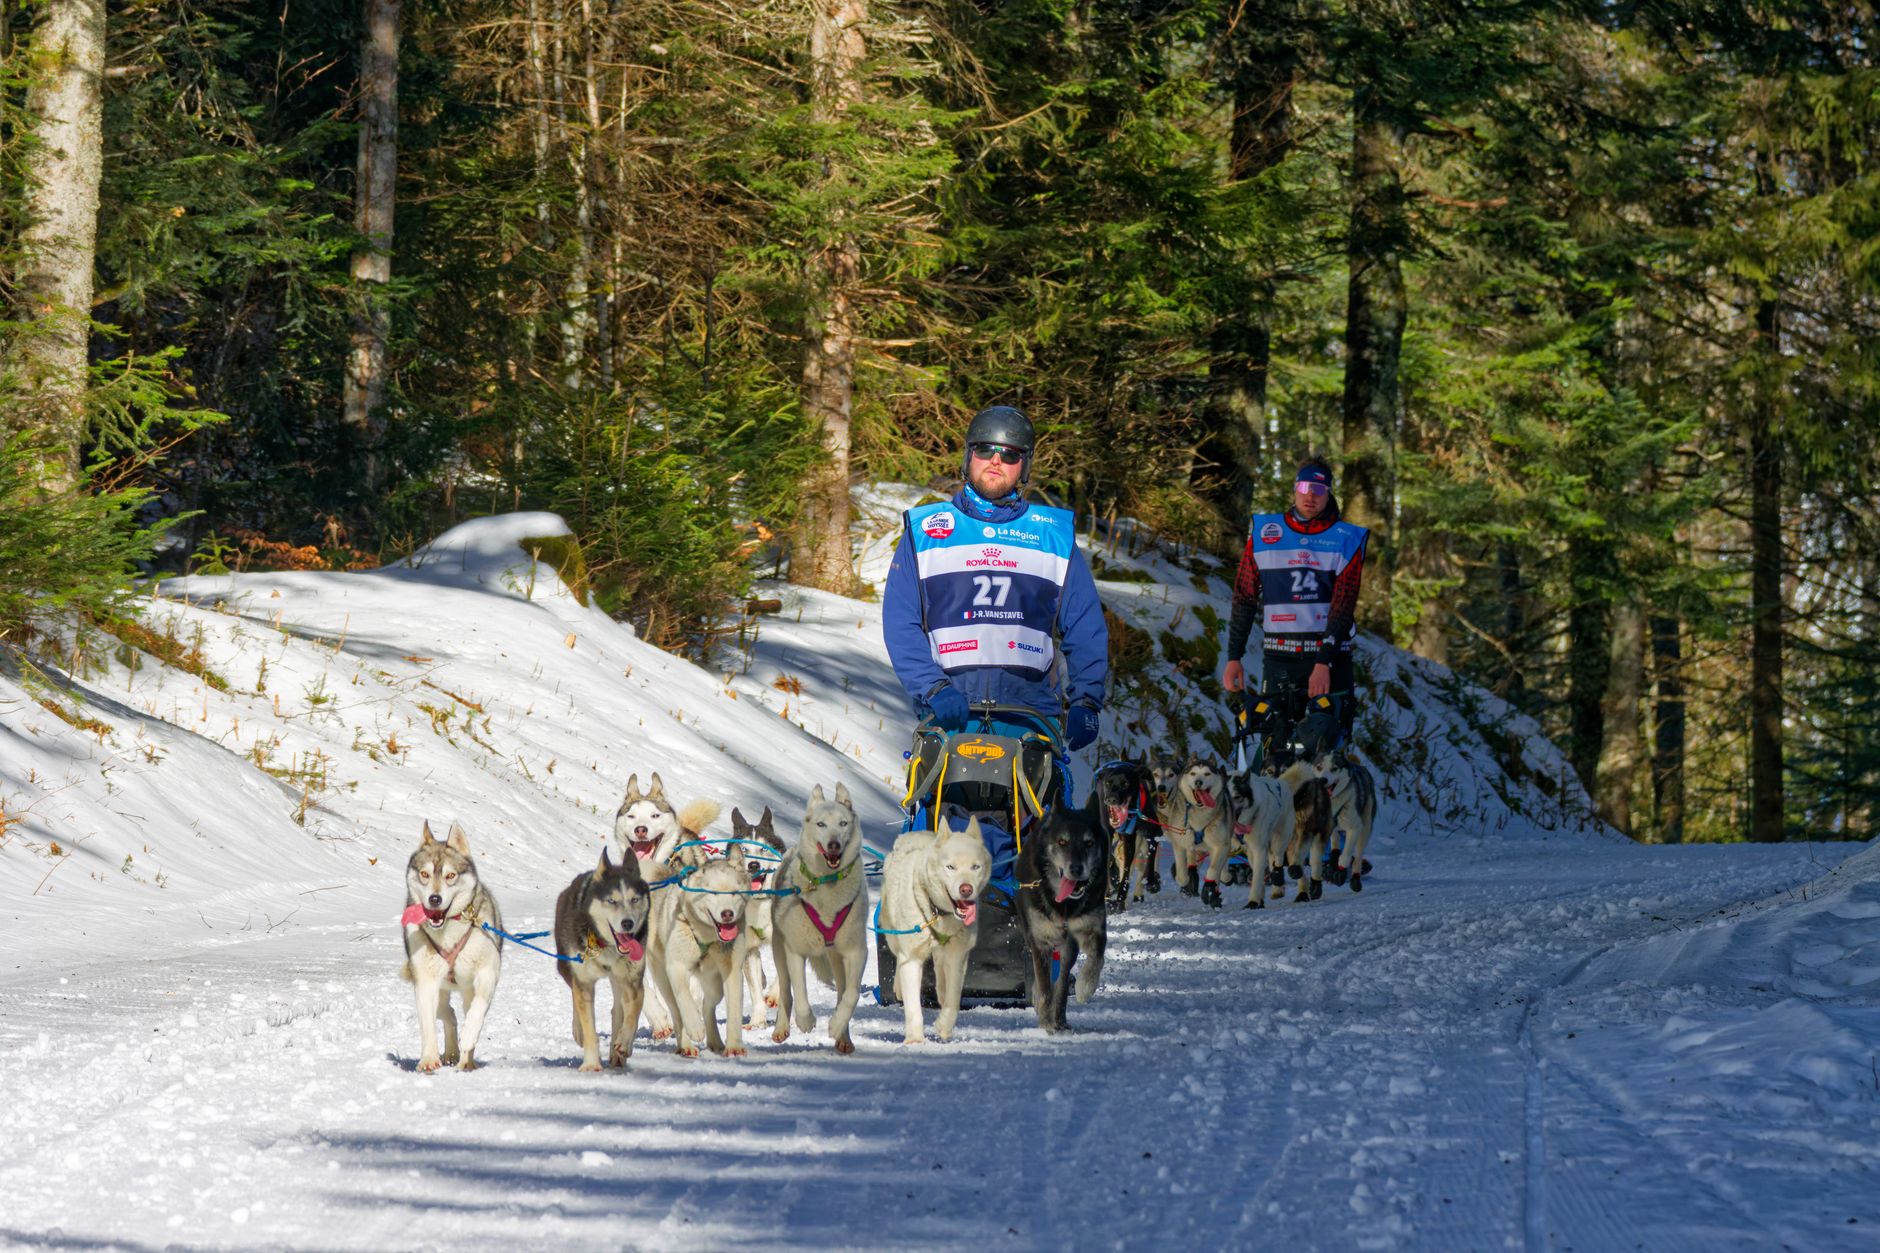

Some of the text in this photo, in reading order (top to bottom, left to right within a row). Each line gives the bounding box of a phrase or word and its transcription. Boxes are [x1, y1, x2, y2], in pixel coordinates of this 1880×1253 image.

[997, 527, 1008, 535] La
[1009, 528, 1040, 541] Région
[966, 559, 1017, 568] ROYAL CANIN
[1290, 570, 1319, 592] 24
[972, 575, 1012, 607] 27
[1017, 642, 1044, 654] SUZUKI
